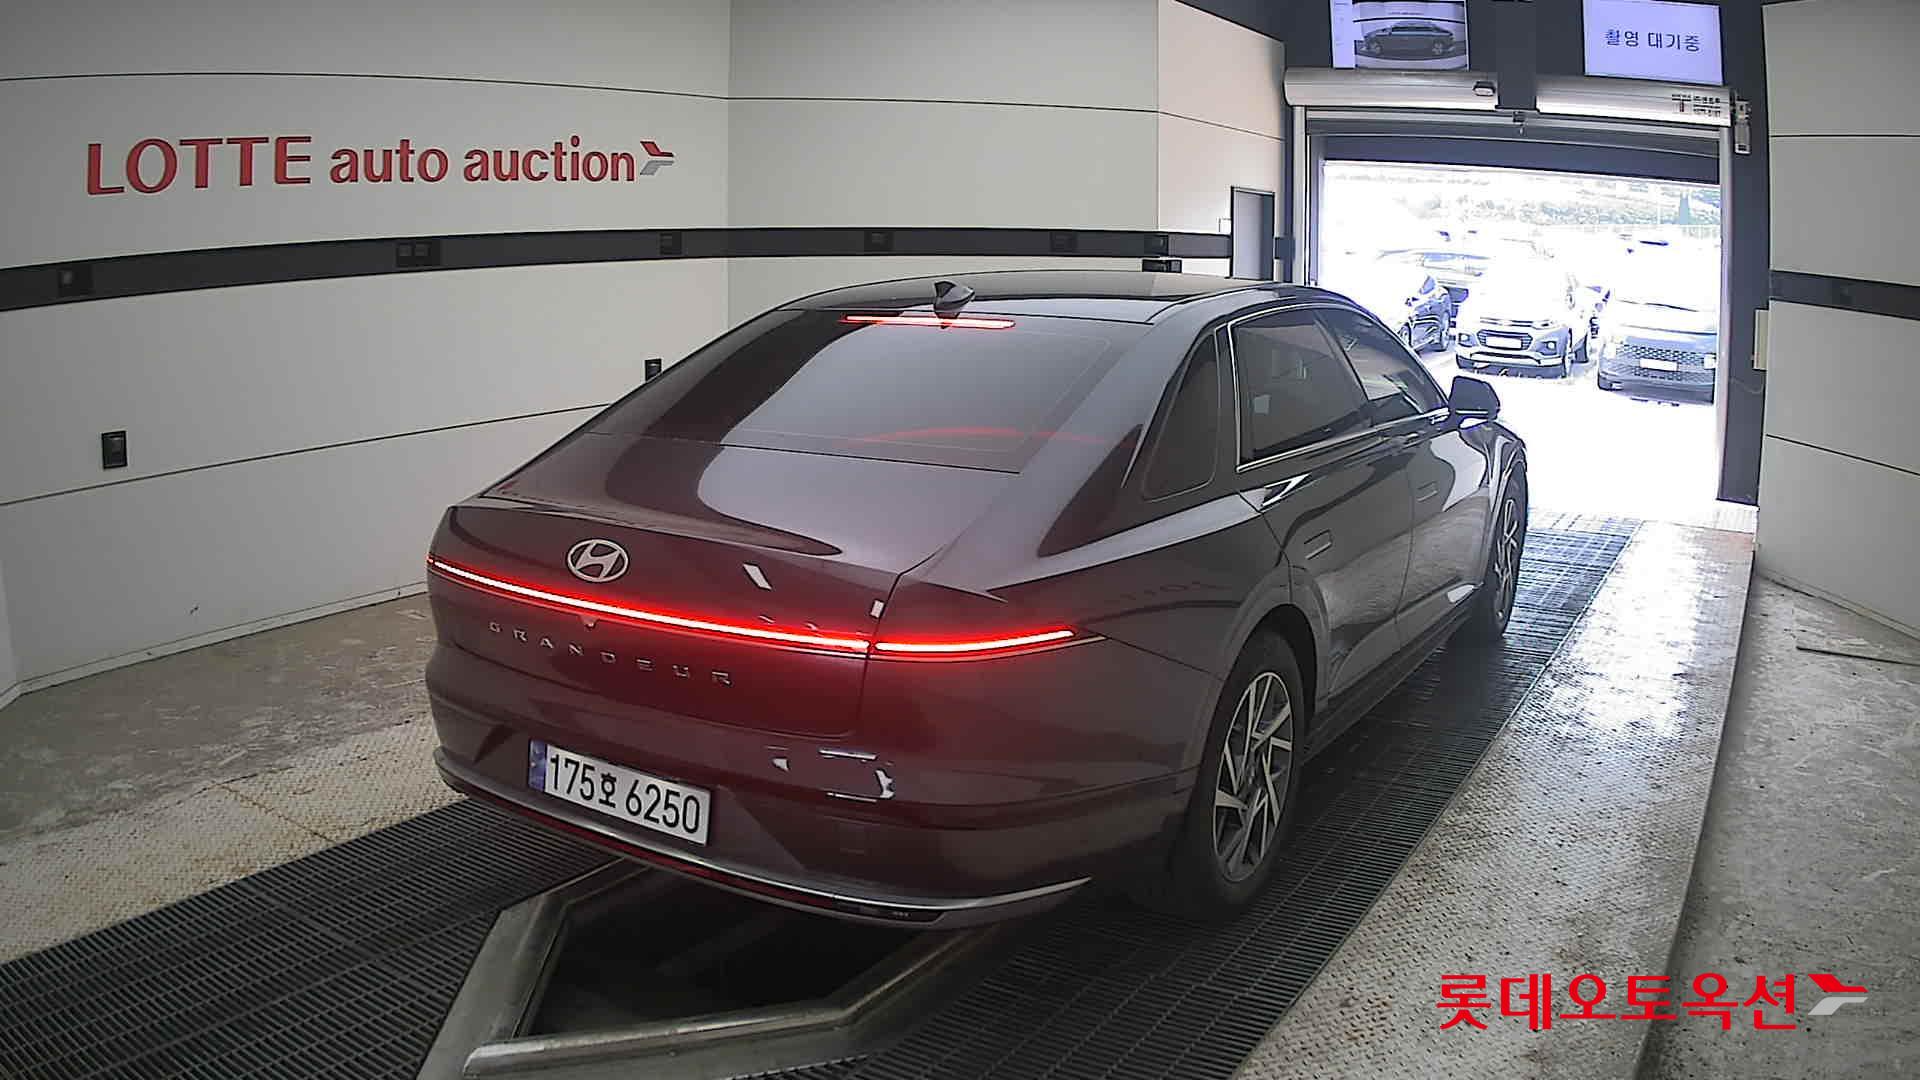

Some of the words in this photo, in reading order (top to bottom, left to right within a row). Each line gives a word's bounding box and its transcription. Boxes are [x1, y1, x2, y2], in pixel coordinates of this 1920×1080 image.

[1647, 31, 1700, 52] 대기중
[87, 136, 311, 195] LOTTE
[329, 138, 448, 183] auto
[463, 135, 634, 182] auction
[489, 621, 733, 687] GRANDEUR
[550, 754, 617, 808] 175호
[625, 779, 700, 834] 6250
